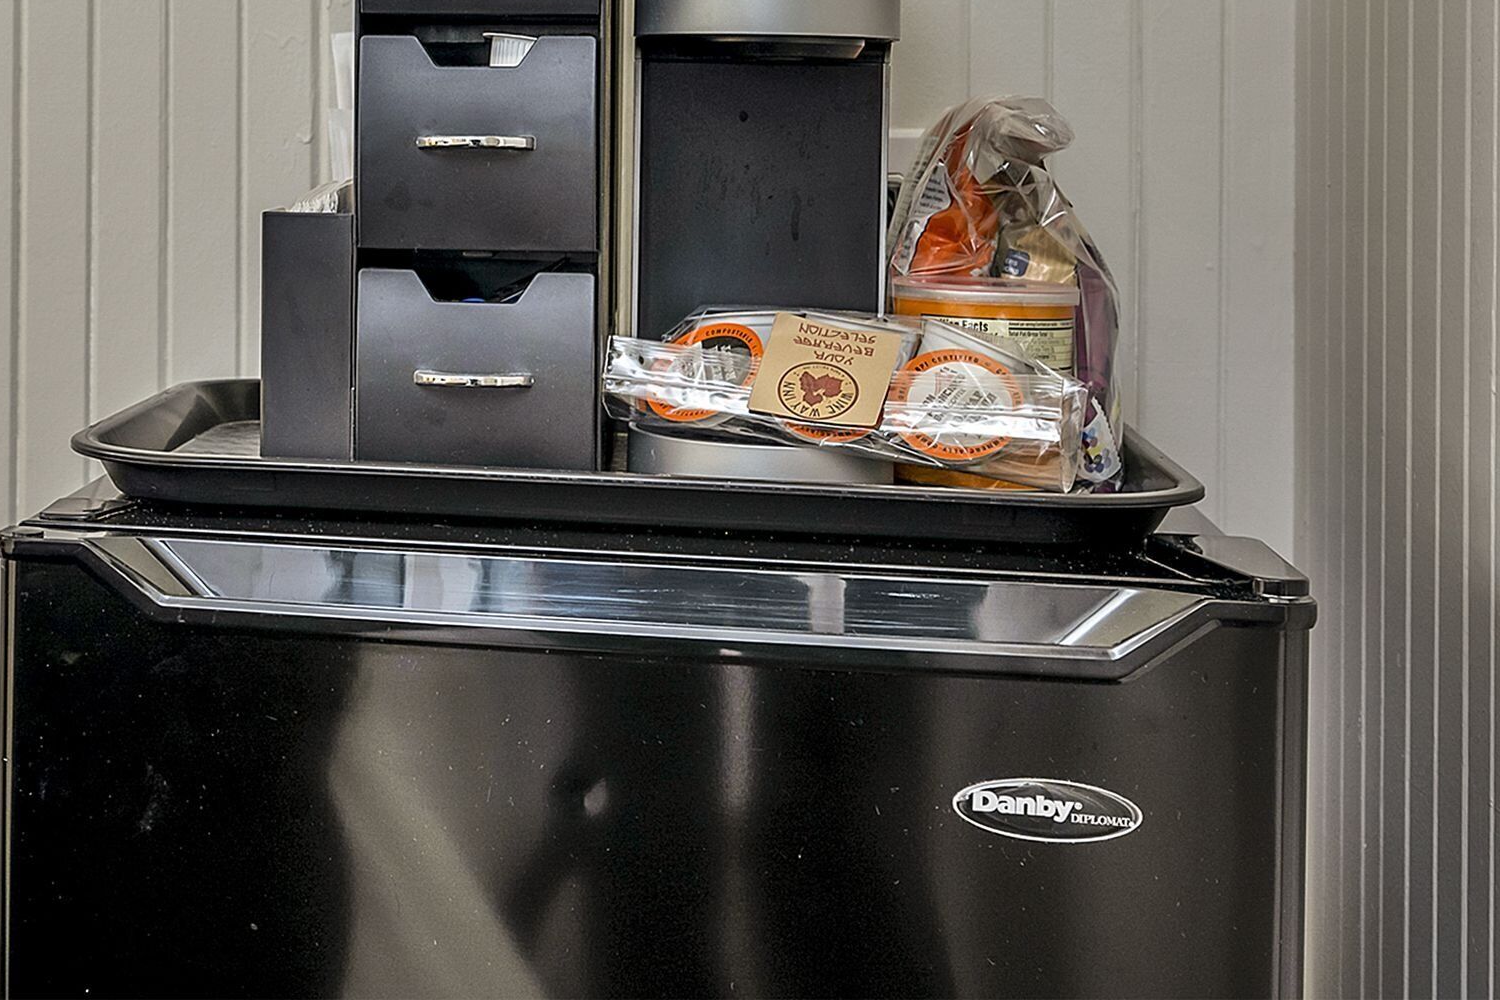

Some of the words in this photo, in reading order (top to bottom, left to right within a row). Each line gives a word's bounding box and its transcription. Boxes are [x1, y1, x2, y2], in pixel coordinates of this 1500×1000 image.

[798, 322, 877, 345] SELECTION
[792, 335, 875, 357] BEVERAGE
[813, 350, 854, 367] YOUR
[931, 354, 980, 364] CERTIFIED
[781, 380, 797, 402] INN
[790, 402, 821, 417] WAY
[825, 392, 854, 415] WINE
[972, 790, 1075, 823] Danby
[1070, 813, 1131, 828] DIPLOMAT
